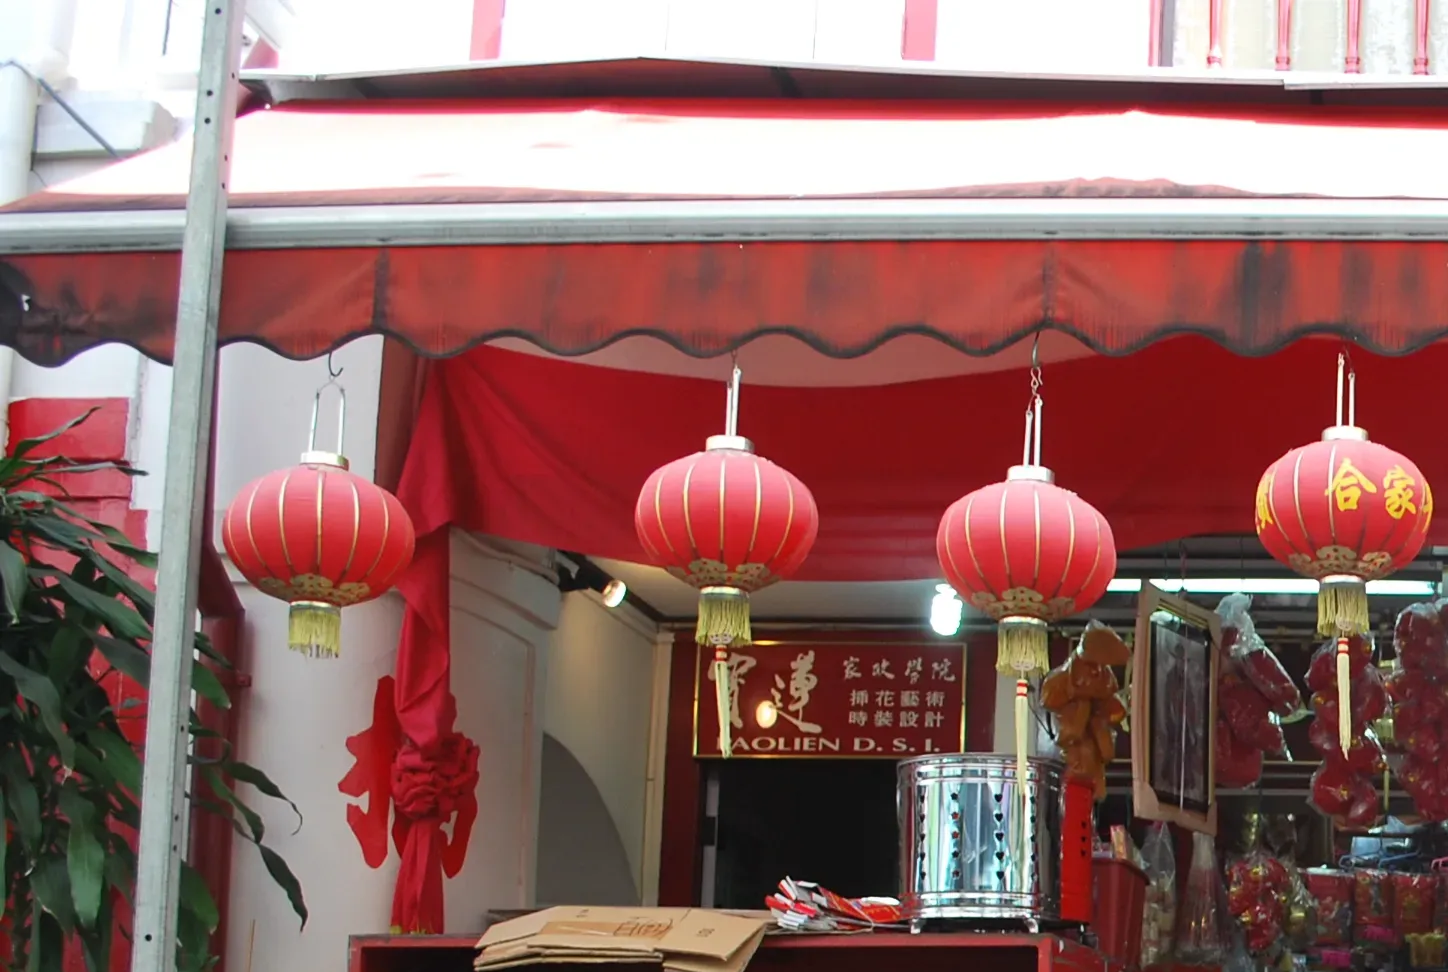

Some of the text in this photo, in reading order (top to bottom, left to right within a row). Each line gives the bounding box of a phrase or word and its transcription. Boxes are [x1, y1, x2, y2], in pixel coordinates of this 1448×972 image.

[716, 735, 840, 752] AOLIEN
[853, 737, 883, 752] D.
[892, 737, 915, 752] S.
